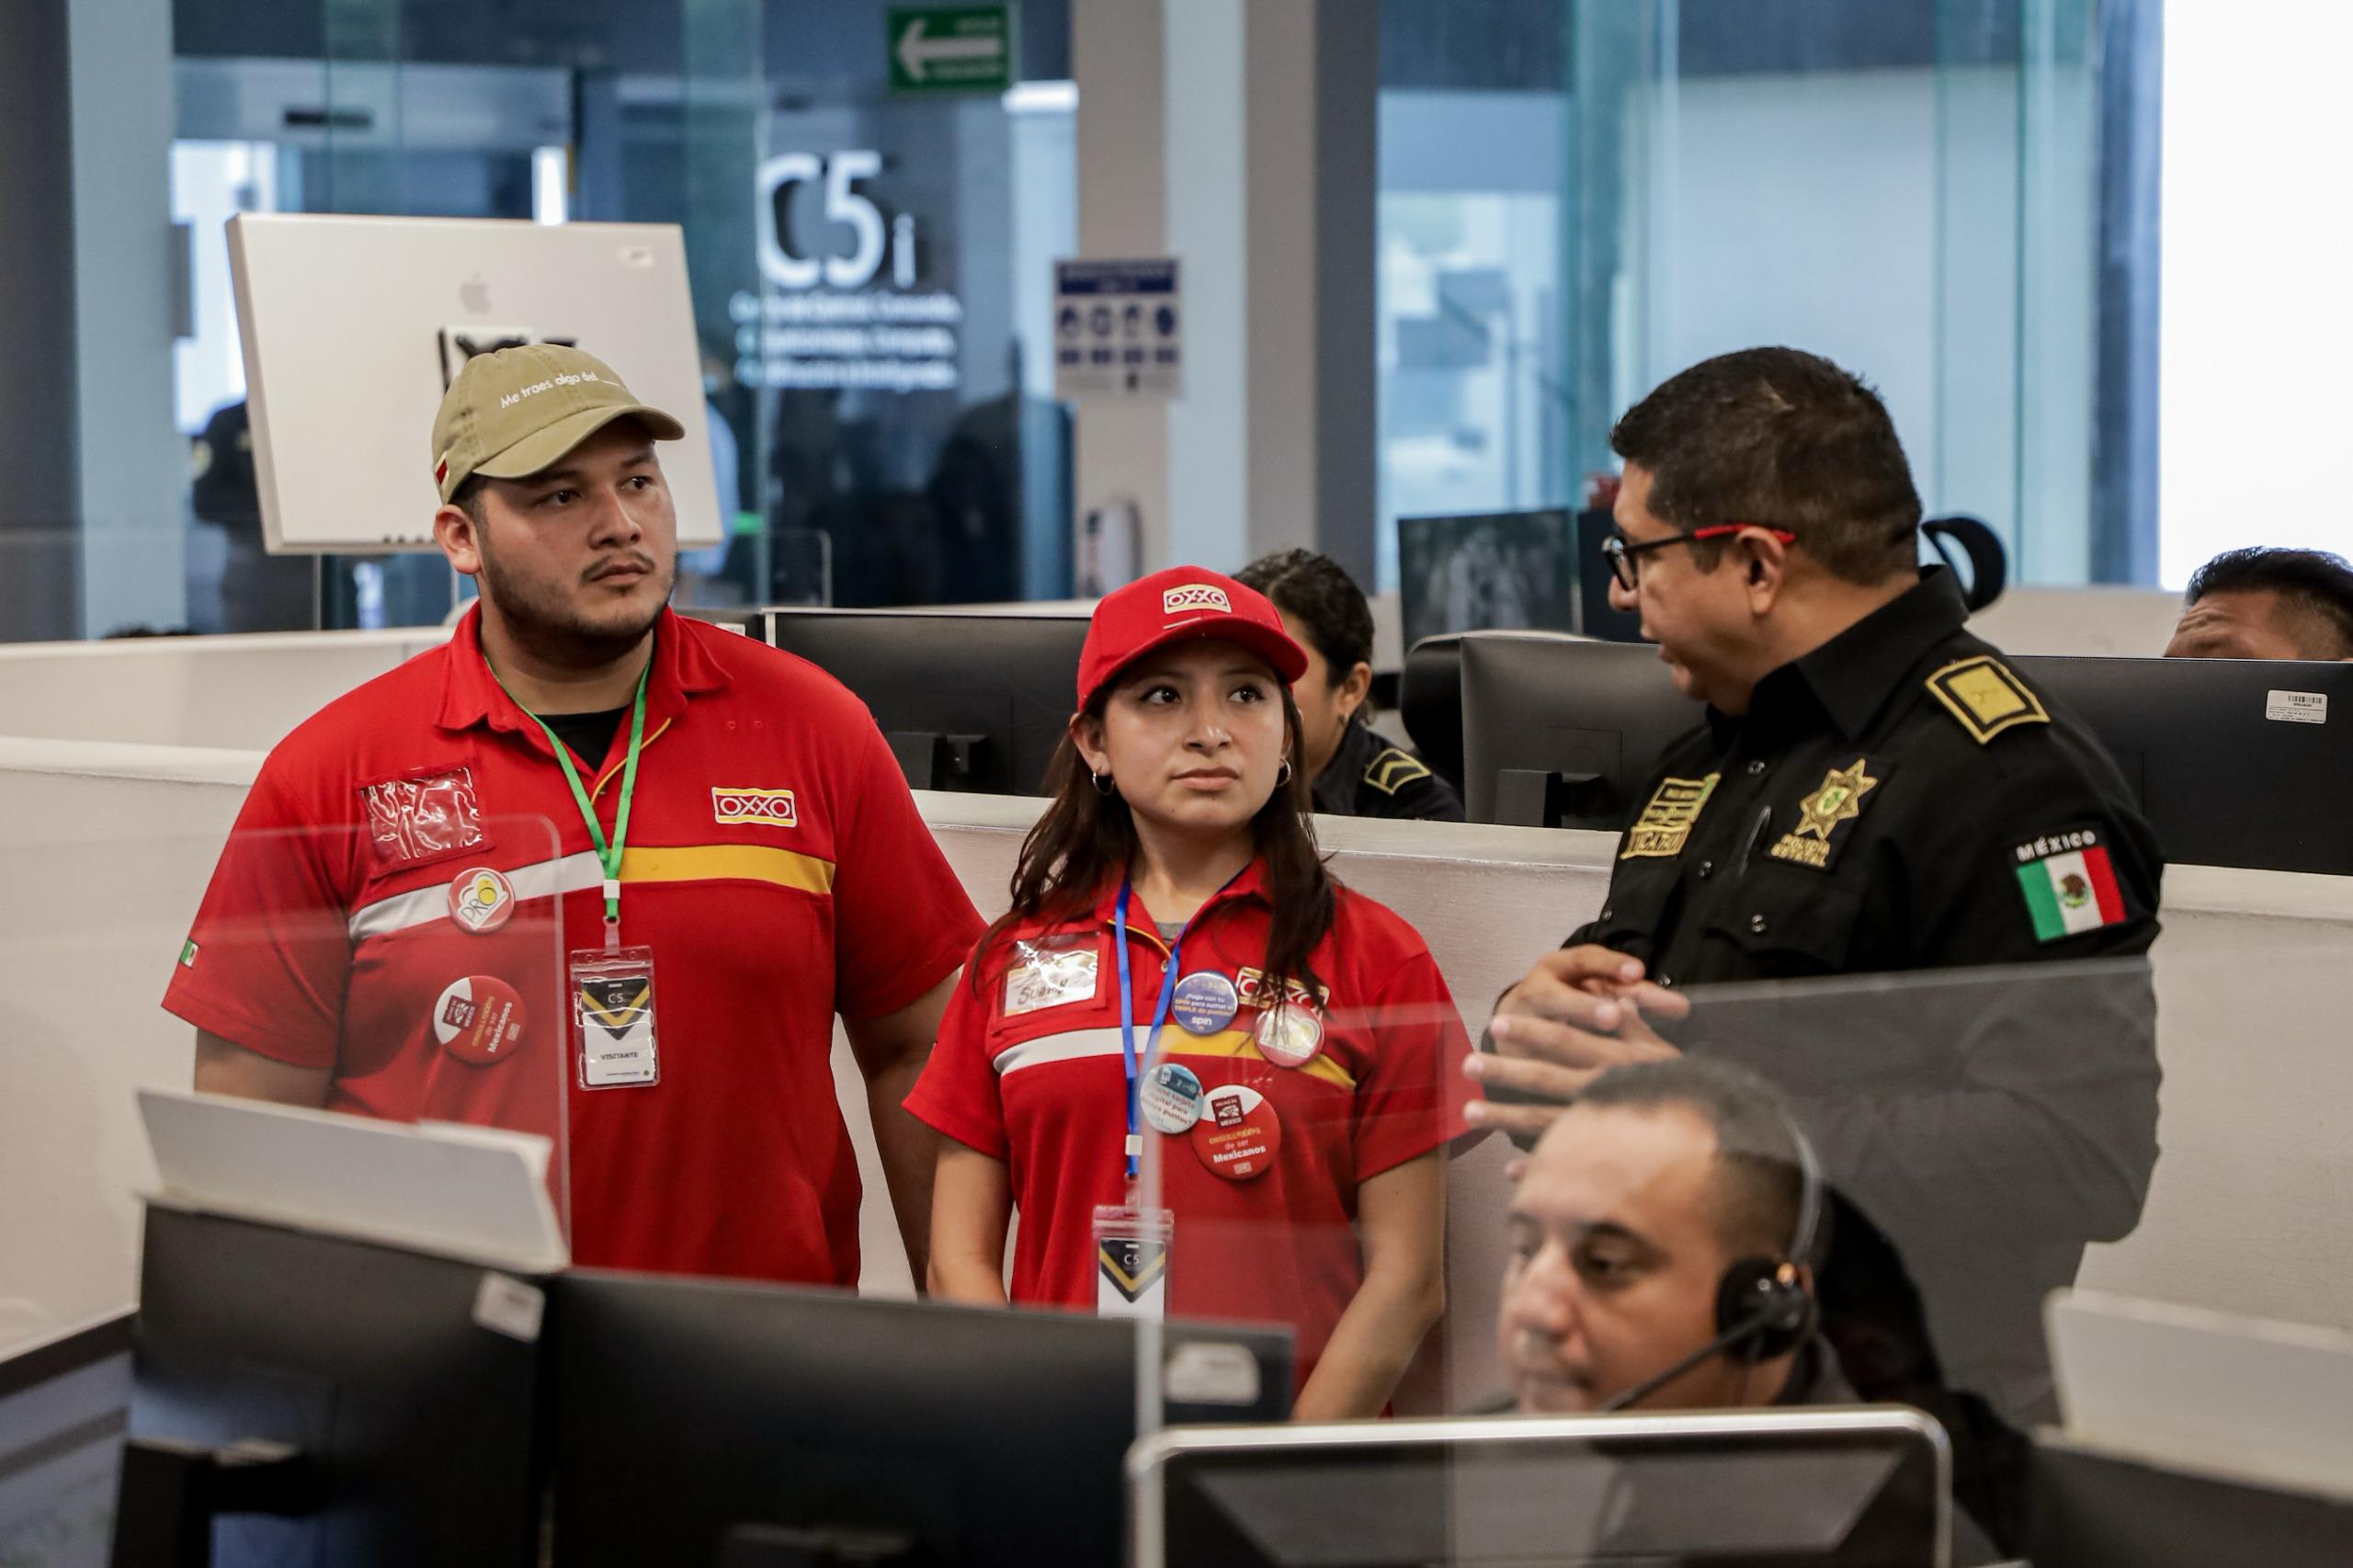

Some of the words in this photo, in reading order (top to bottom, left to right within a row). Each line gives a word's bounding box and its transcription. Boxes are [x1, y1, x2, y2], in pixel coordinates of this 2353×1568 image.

[756, 150, 916, 289] C5i
[500, 393, 520, 409] Me
[520, 380, 553, 397] traes
[554, 372, 581, 386] algo
[1167, 588, 1227, 607] OXXO
[719, 794, 791, 818] OXXO
[2016, 830, 2096, 862] MÉXICO
[487, 1002, 513, 1053] Mexicanos
[1191, 1017, 1212, 1026] spin
[600, 1051, 639, 1061] VISITANTE
[1213, 1145, 1267, 1164] Mexicanos
